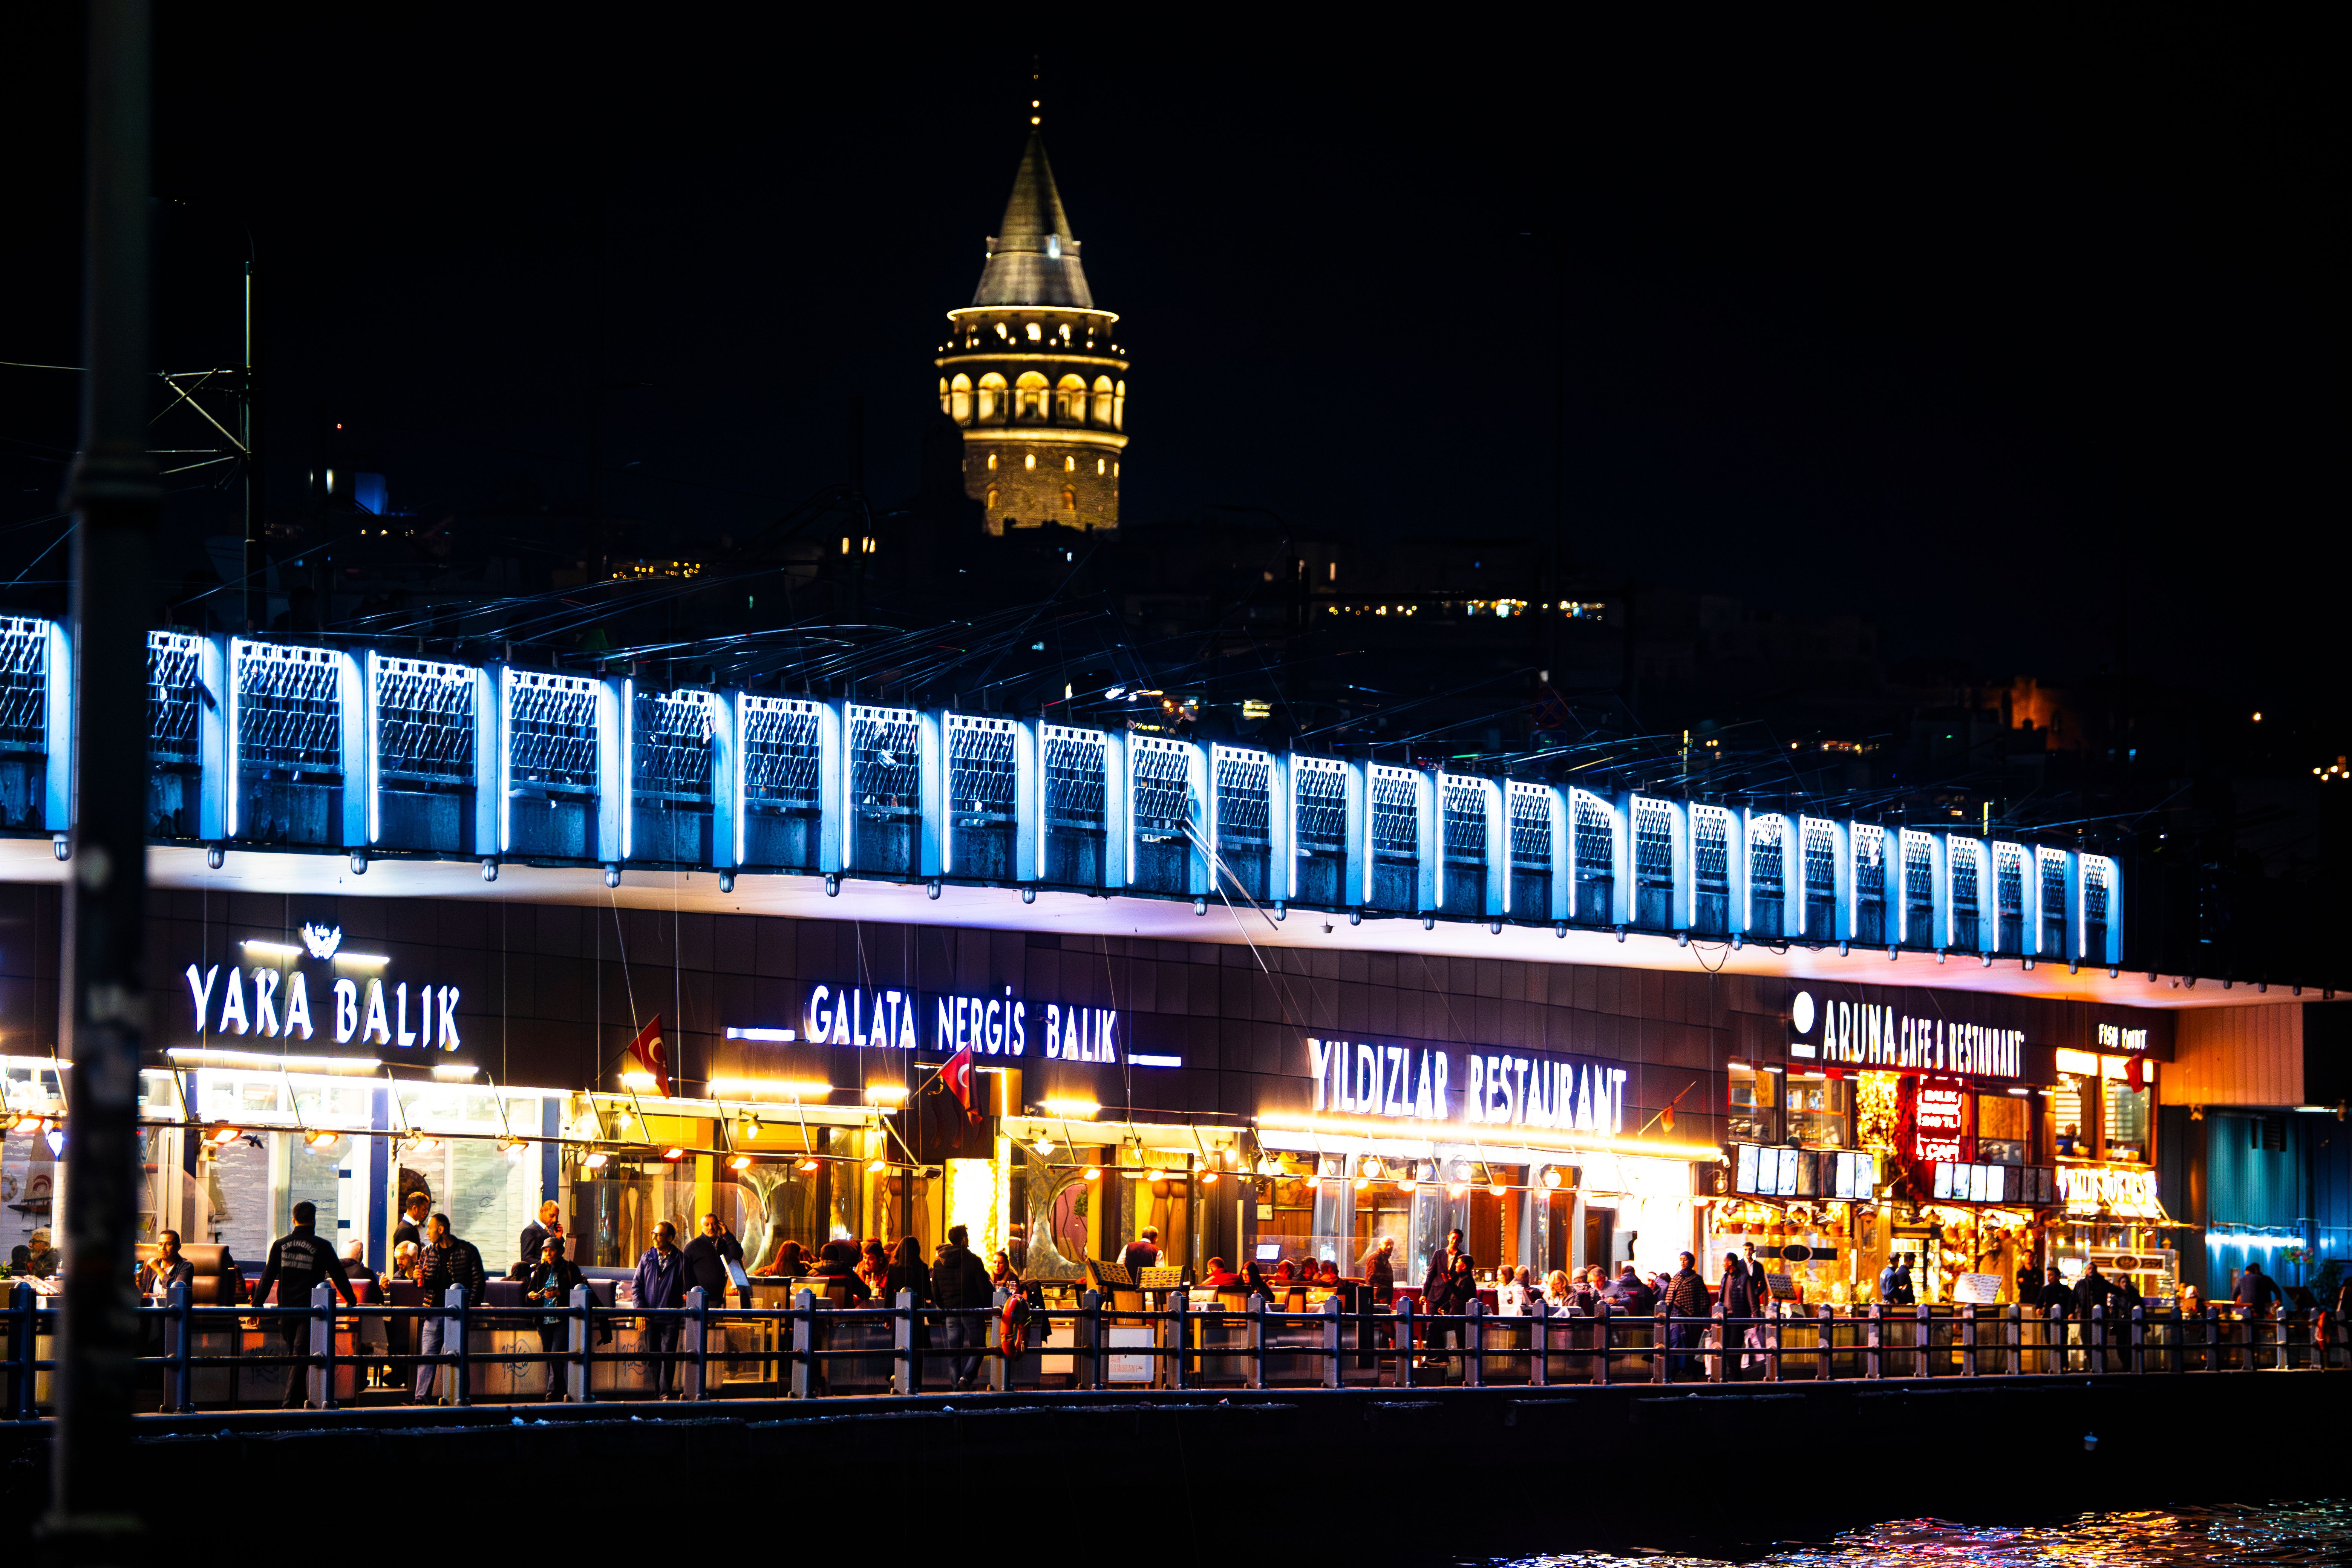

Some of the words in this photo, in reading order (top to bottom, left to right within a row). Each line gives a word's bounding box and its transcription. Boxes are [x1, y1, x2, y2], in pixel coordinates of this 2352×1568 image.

[186, 963, 313, 1040] YAKA
[334, 978, 460, 1051] BALIK
[808, 985, 916, 1048] GALATA
[938, 986, 1025, 1056] NERGİS
[1047, 1004, 1116, 1063] BALIK
[1823, 1000, 1895, 1064] ARUNA
[1901, 1015, 1931, 1069] CAFE
[1949, 1023, 2021, 1078] RESTAURANT
[1312, 1039, 1448, 1119] YILDIZLAR
[1469, 1055, 1626, 1134] RESTAURANT
